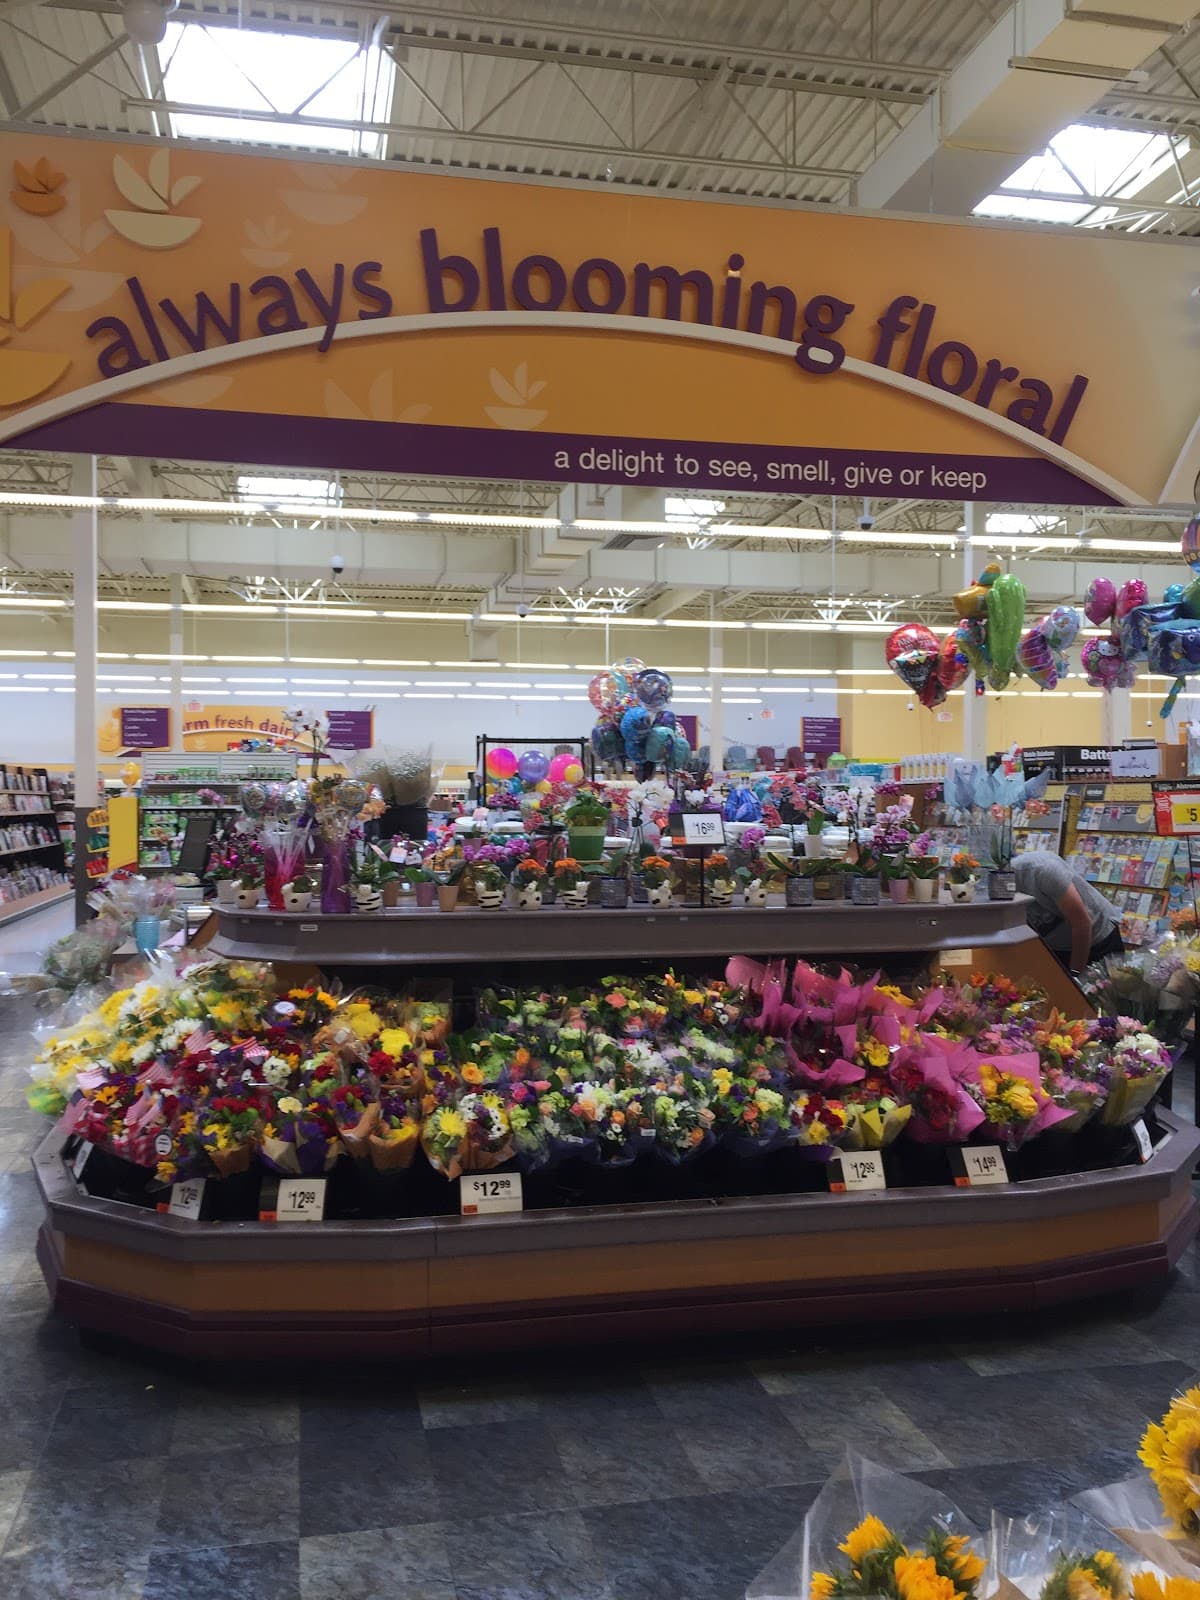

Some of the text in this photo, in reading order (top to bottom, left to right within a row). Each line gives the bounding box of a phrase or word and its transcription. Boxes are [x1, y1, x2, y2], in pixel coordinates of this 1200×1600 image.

[86, 227, 1089, 445] always blooming floral
[554, 448, 988, 494] a delight to see, smell, give or keep
[215, 714, 254, 730] fresh
